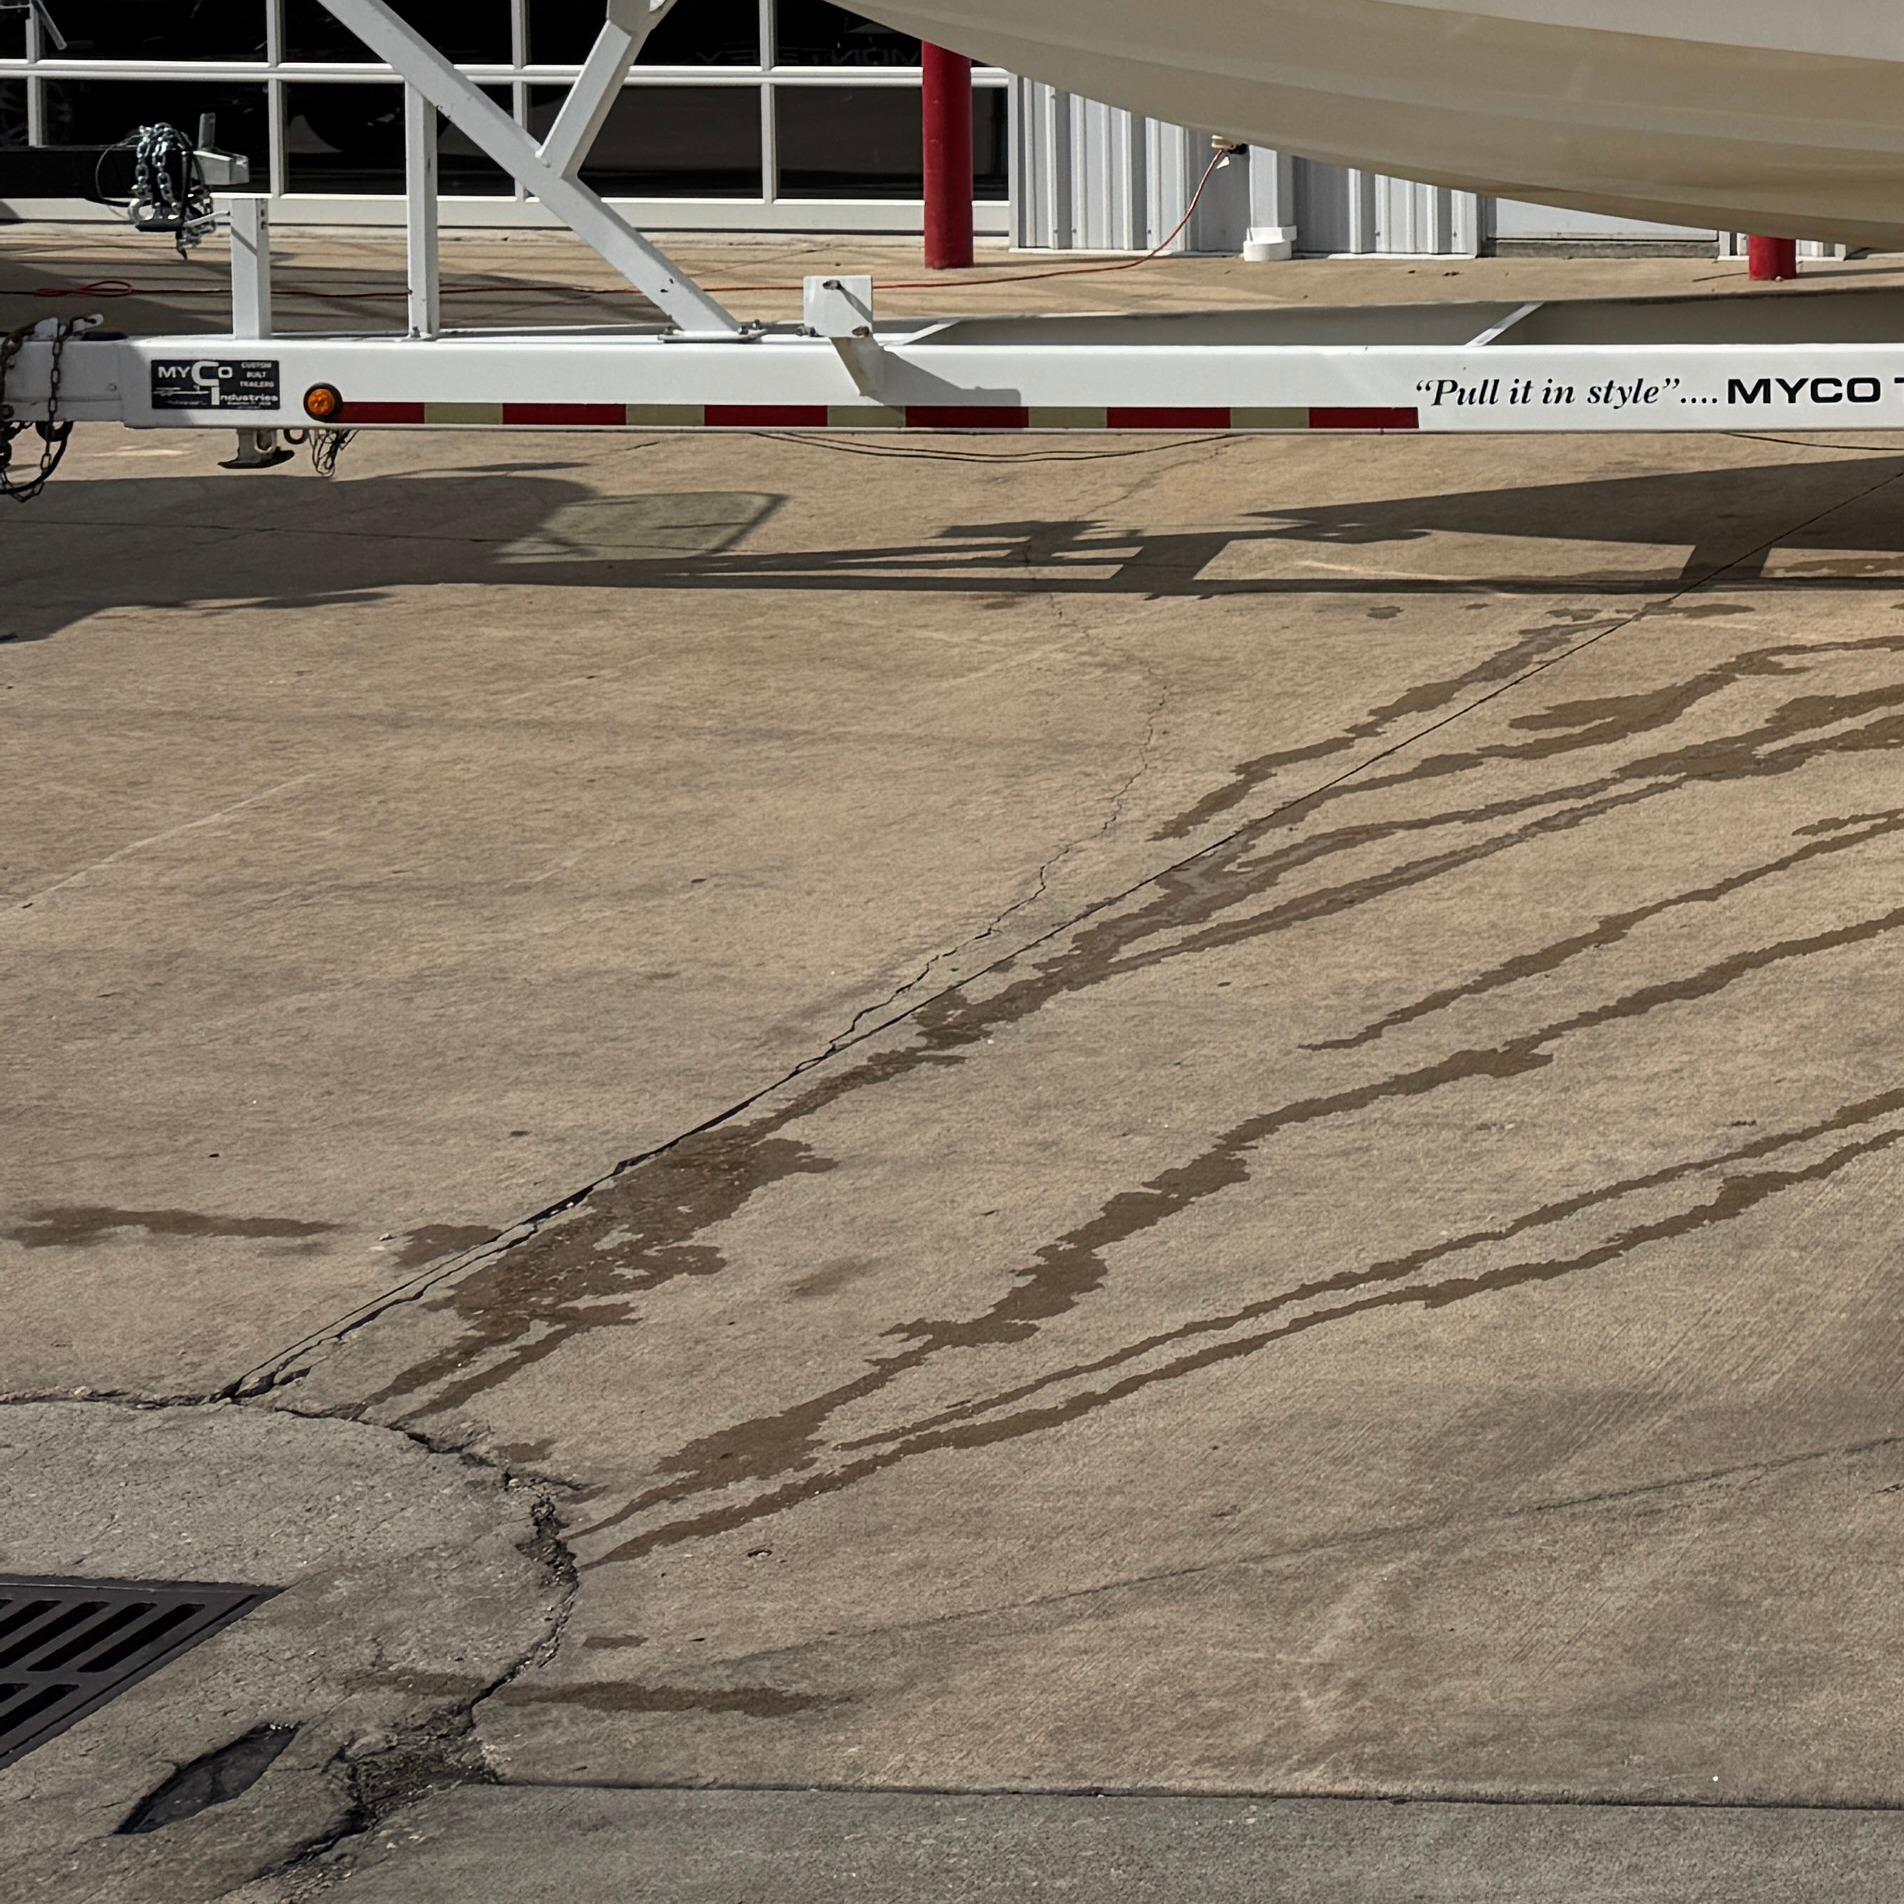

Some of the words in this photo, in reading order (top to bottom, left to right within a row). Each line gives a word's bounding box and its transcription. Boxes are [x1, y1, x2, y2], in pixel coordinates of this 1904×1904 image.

[158, 360, 233, 387] MYCO
[1509, 378, 1531, 405] it
[1542, 378, 1575, 405] in
[1728, 377, 1881, 404] MYCO
